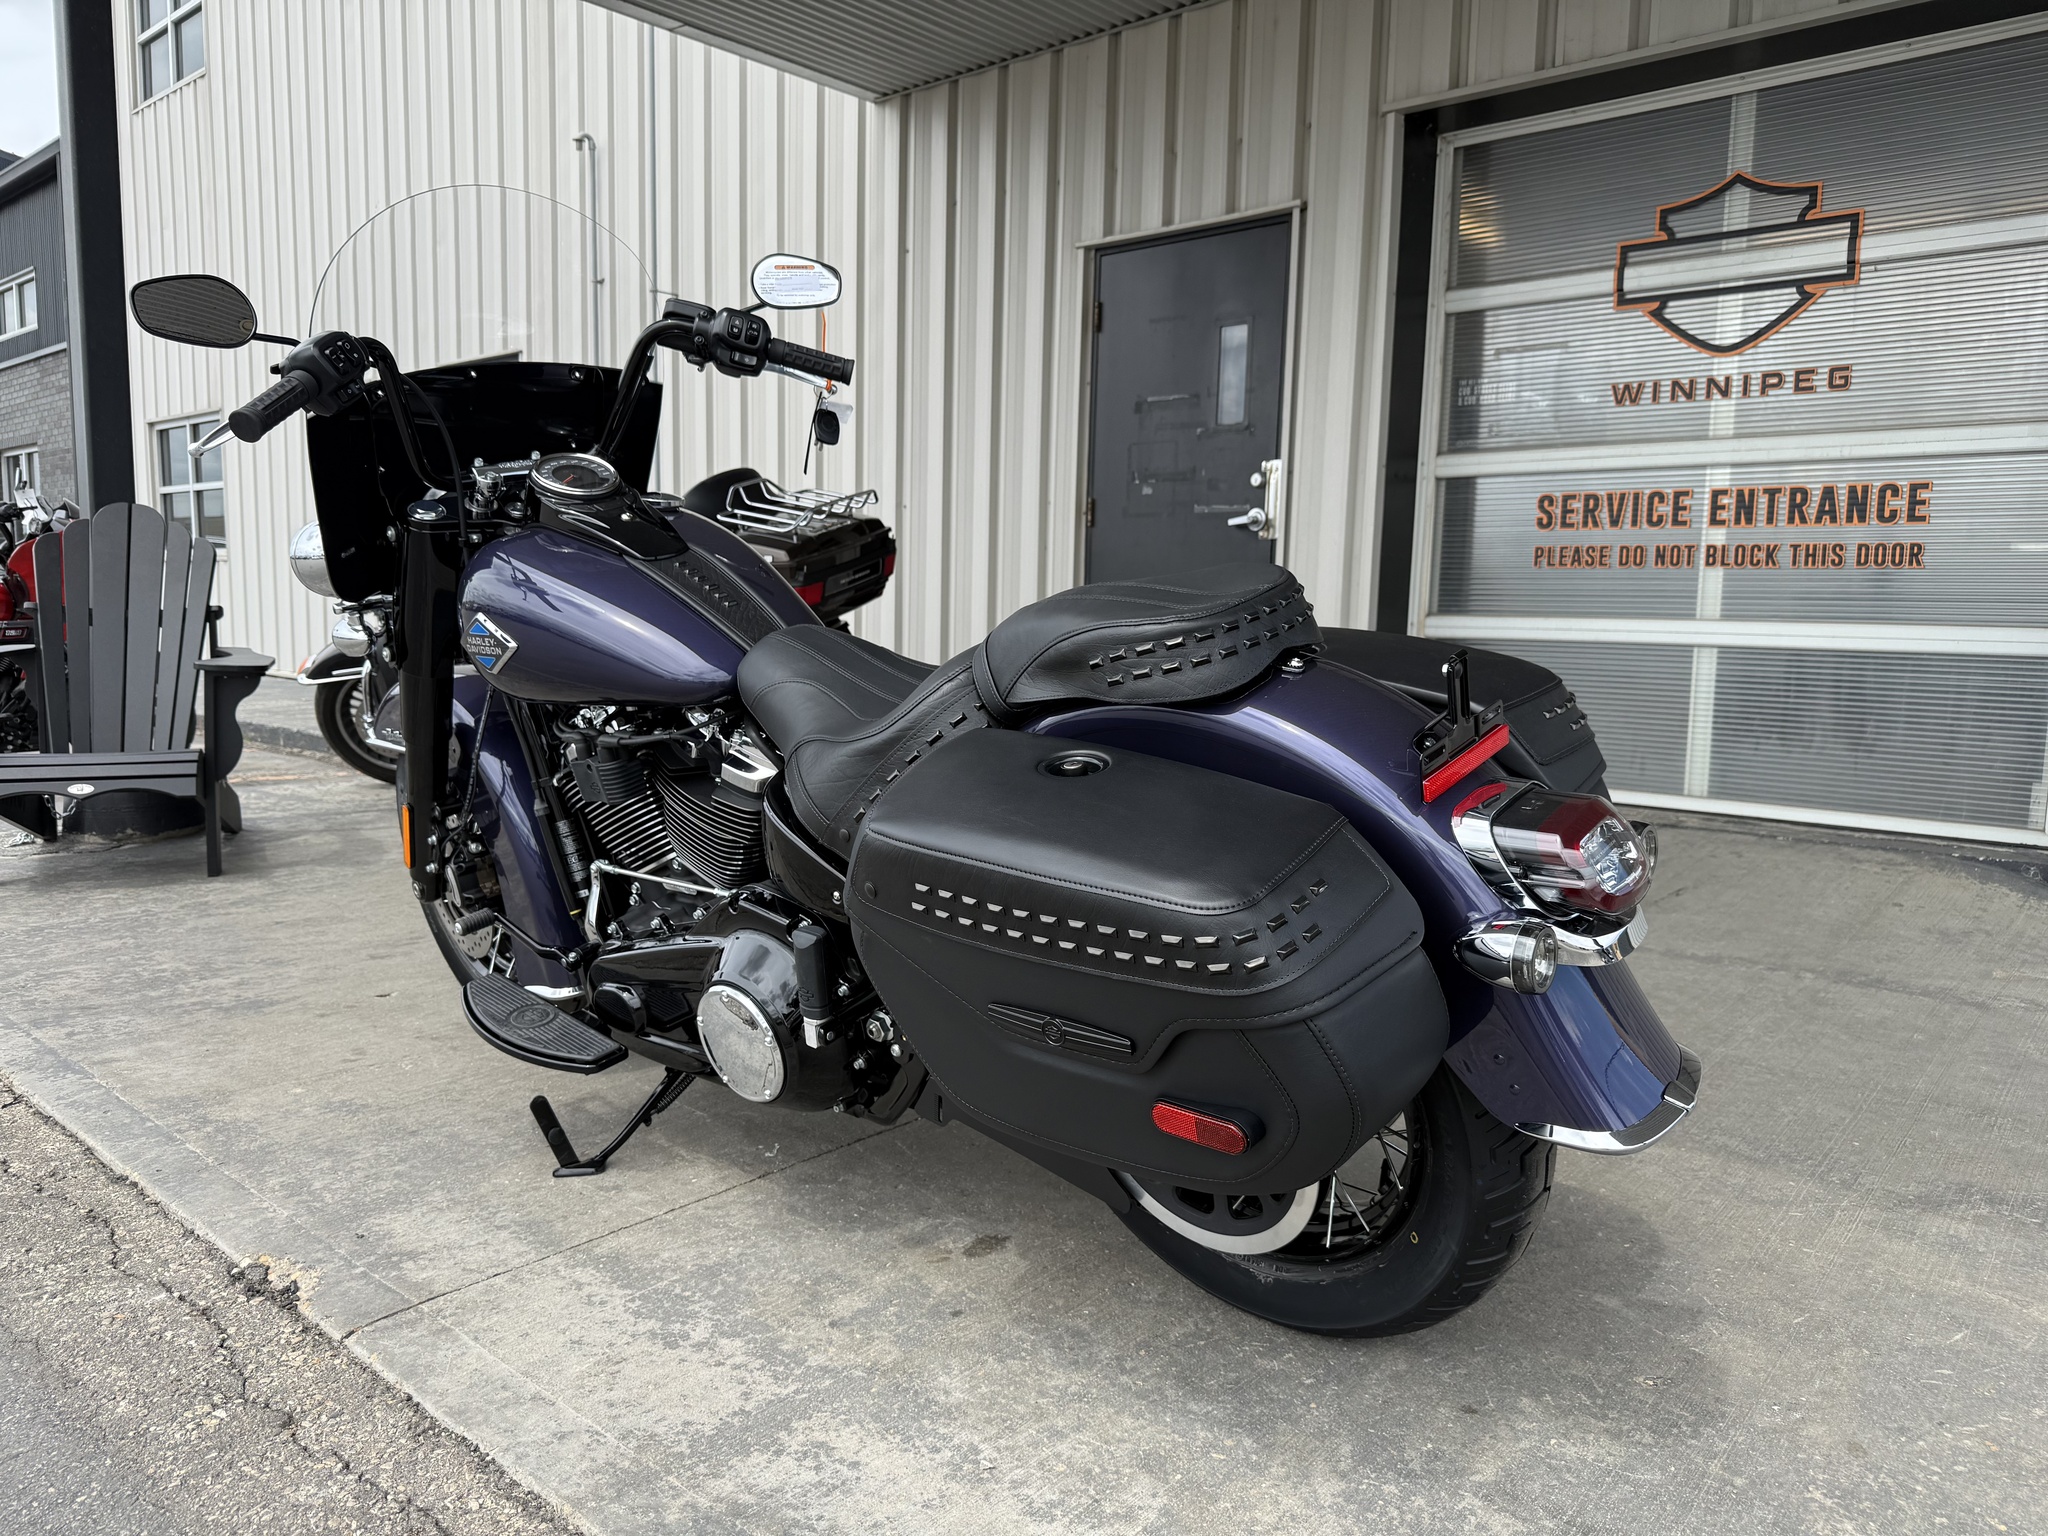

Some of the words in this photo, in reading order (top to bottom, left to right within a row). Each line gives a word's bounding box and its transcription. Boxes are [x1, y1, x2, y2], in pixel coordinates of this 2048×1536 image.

[1610, 364, 1853, 407] WINNIPEG
[1535, 488, 1693, 532] SERVICE
[1707, 481, 1933, 528] ENTRANCE
[1533, 544, 1611, 570] PLEASE
[1617, 543, 1647, 570] DO
[1653, 543, 1698, 570] NOT
[1704, 542, 1782, 570] BLOCK
[1788, 542, 1846, 570] THIS
[1854, 541, 1926, 570] DOOR
[466, 644, 502, 656] DAVIDSON
